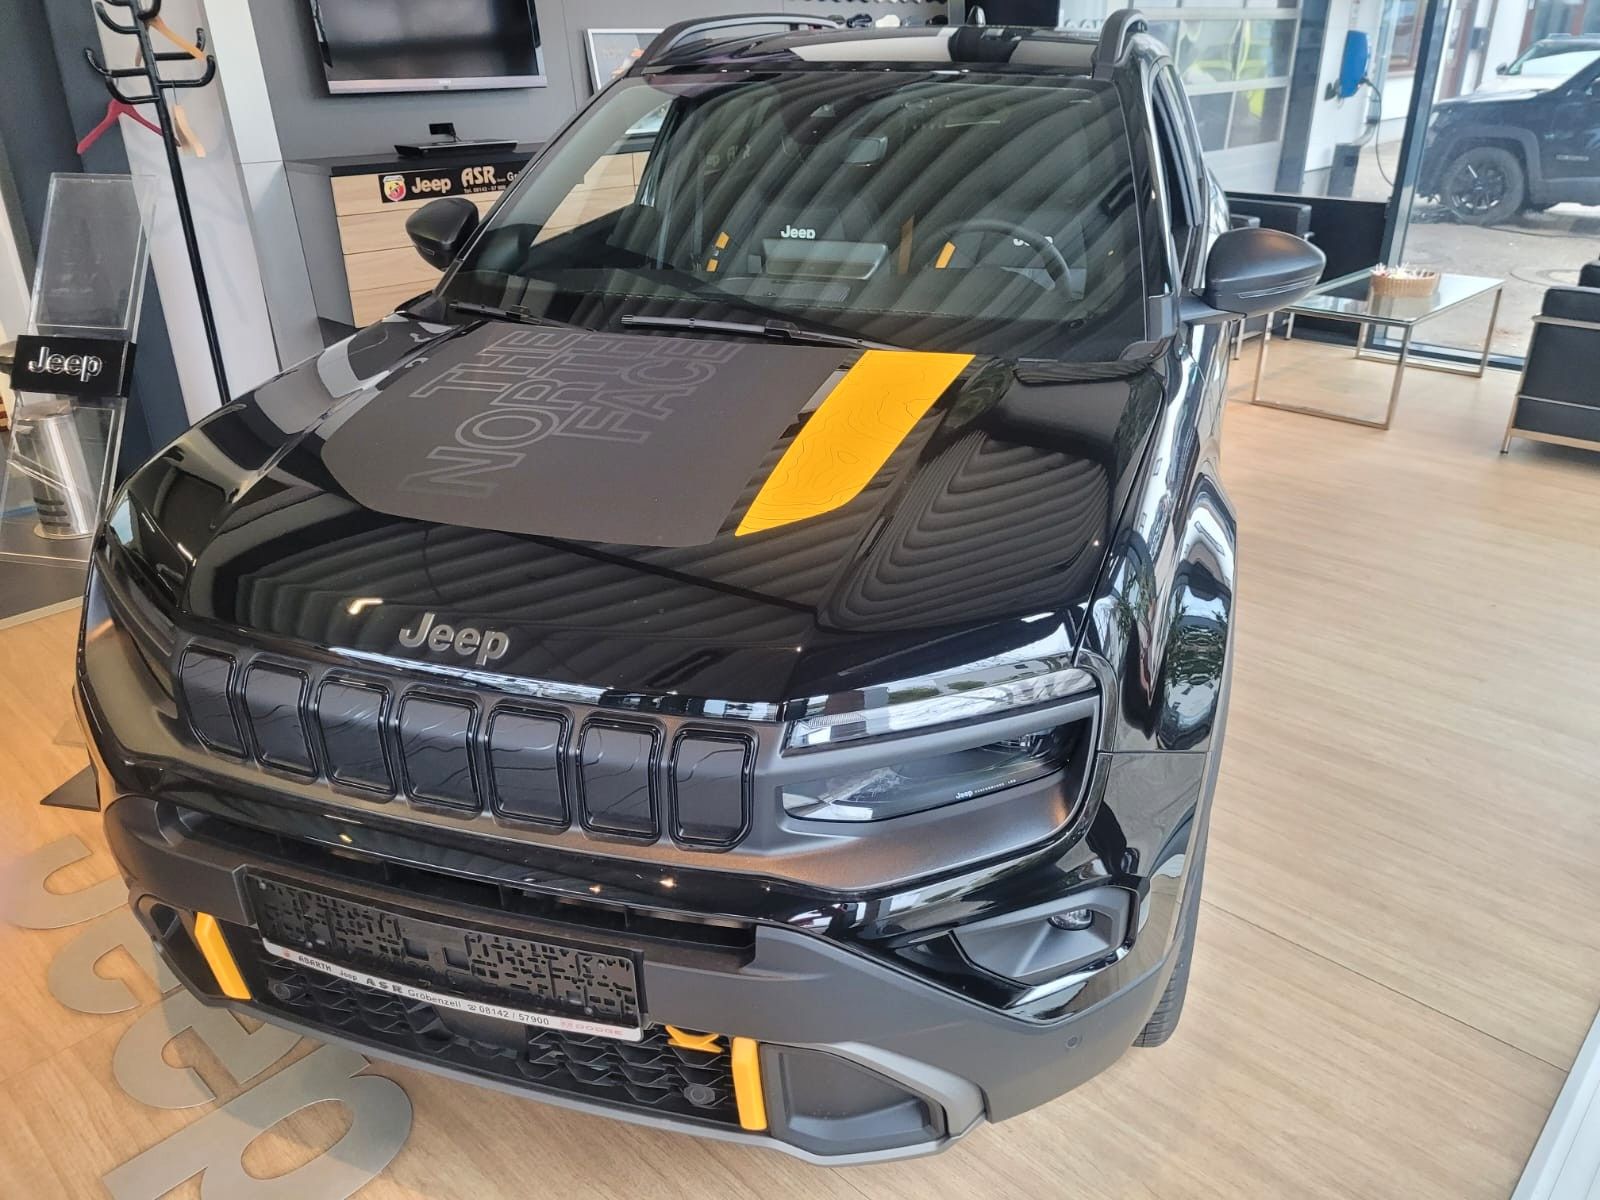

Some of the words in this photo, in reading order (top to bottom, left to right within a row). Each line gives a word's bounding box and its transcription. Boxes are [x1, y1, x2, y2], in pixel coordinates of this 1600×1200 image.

[411, 177, 452, 194] Jeep
[461, 165, 496, 188] ASR
[780, 224, 816, 240] Jeep
[28, 346, 103, 382] Jeep
[408, 330, 587, 398] THE
[551, 339, 747, 445] FACE
[398, 333, 665, 498] NORTH
[398, 611, 510, 667] Jeep
[955, 790, 974, 799] Jeep
[298, 955, 332, 972] ABARTH
[407, 988, 462, 1009] Gröbenzell
[479, 1006, 509, 1018] 08142
[518, 1013, 550, 1026] 57900
